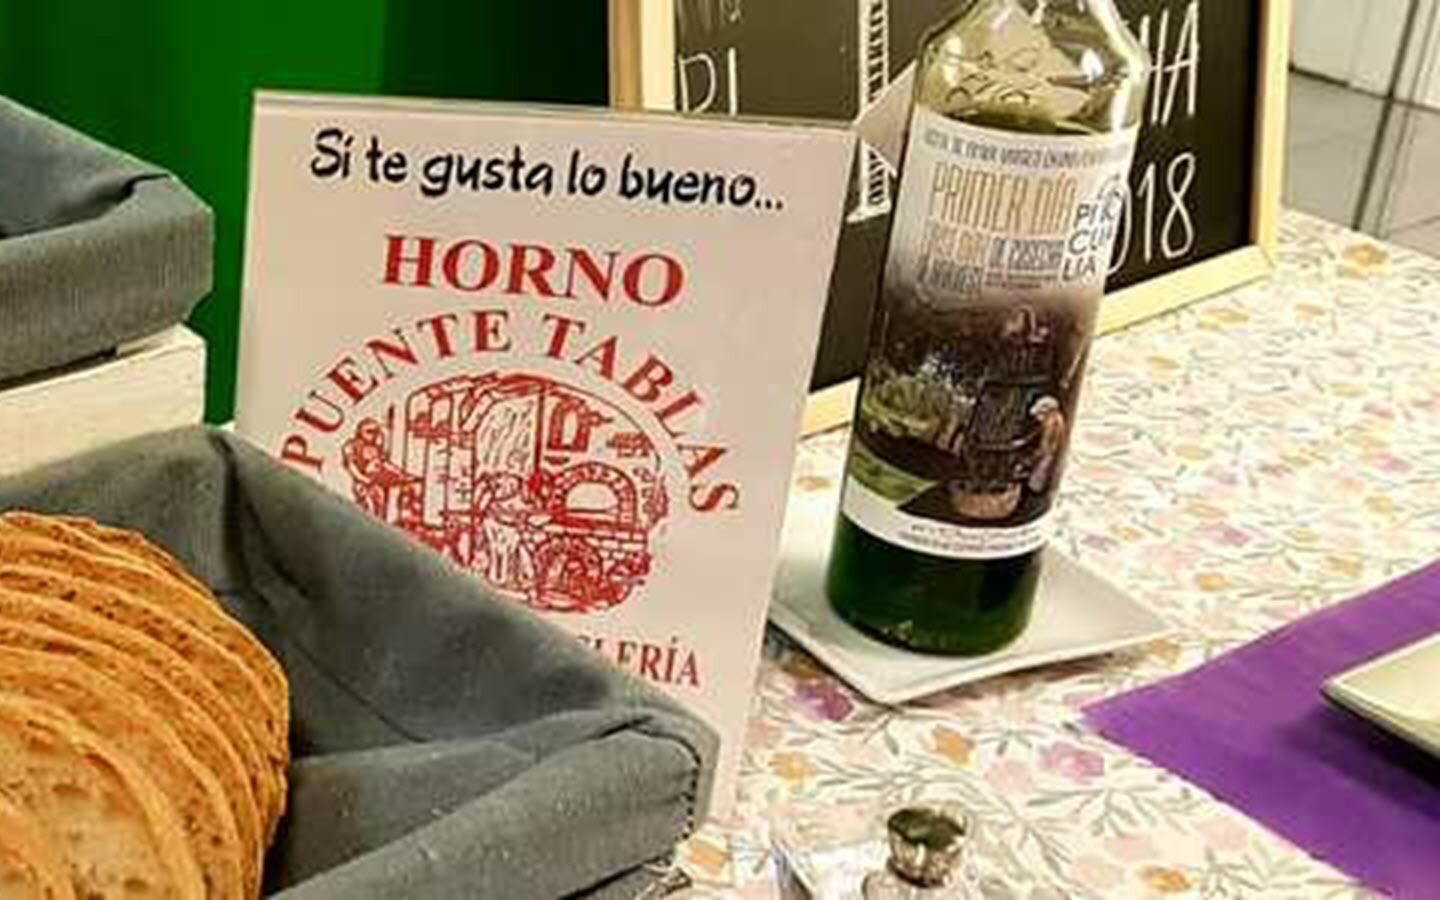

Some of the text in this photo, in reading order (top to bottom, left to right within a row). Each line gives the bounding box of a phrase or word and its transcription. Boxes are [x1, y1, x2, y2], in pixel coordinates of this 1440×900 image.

[365, 136, 409, 184] te
[420, 145, 553, 198] gusta
[566, 149, 607, 197] lo
[618, 152, 785, 212] bueno...
[931, 162, 1030, 233] PRIMER
[382, 234, 686, 308] HORNO
[280, 309, 740, 514] PUENTE TABLAS
